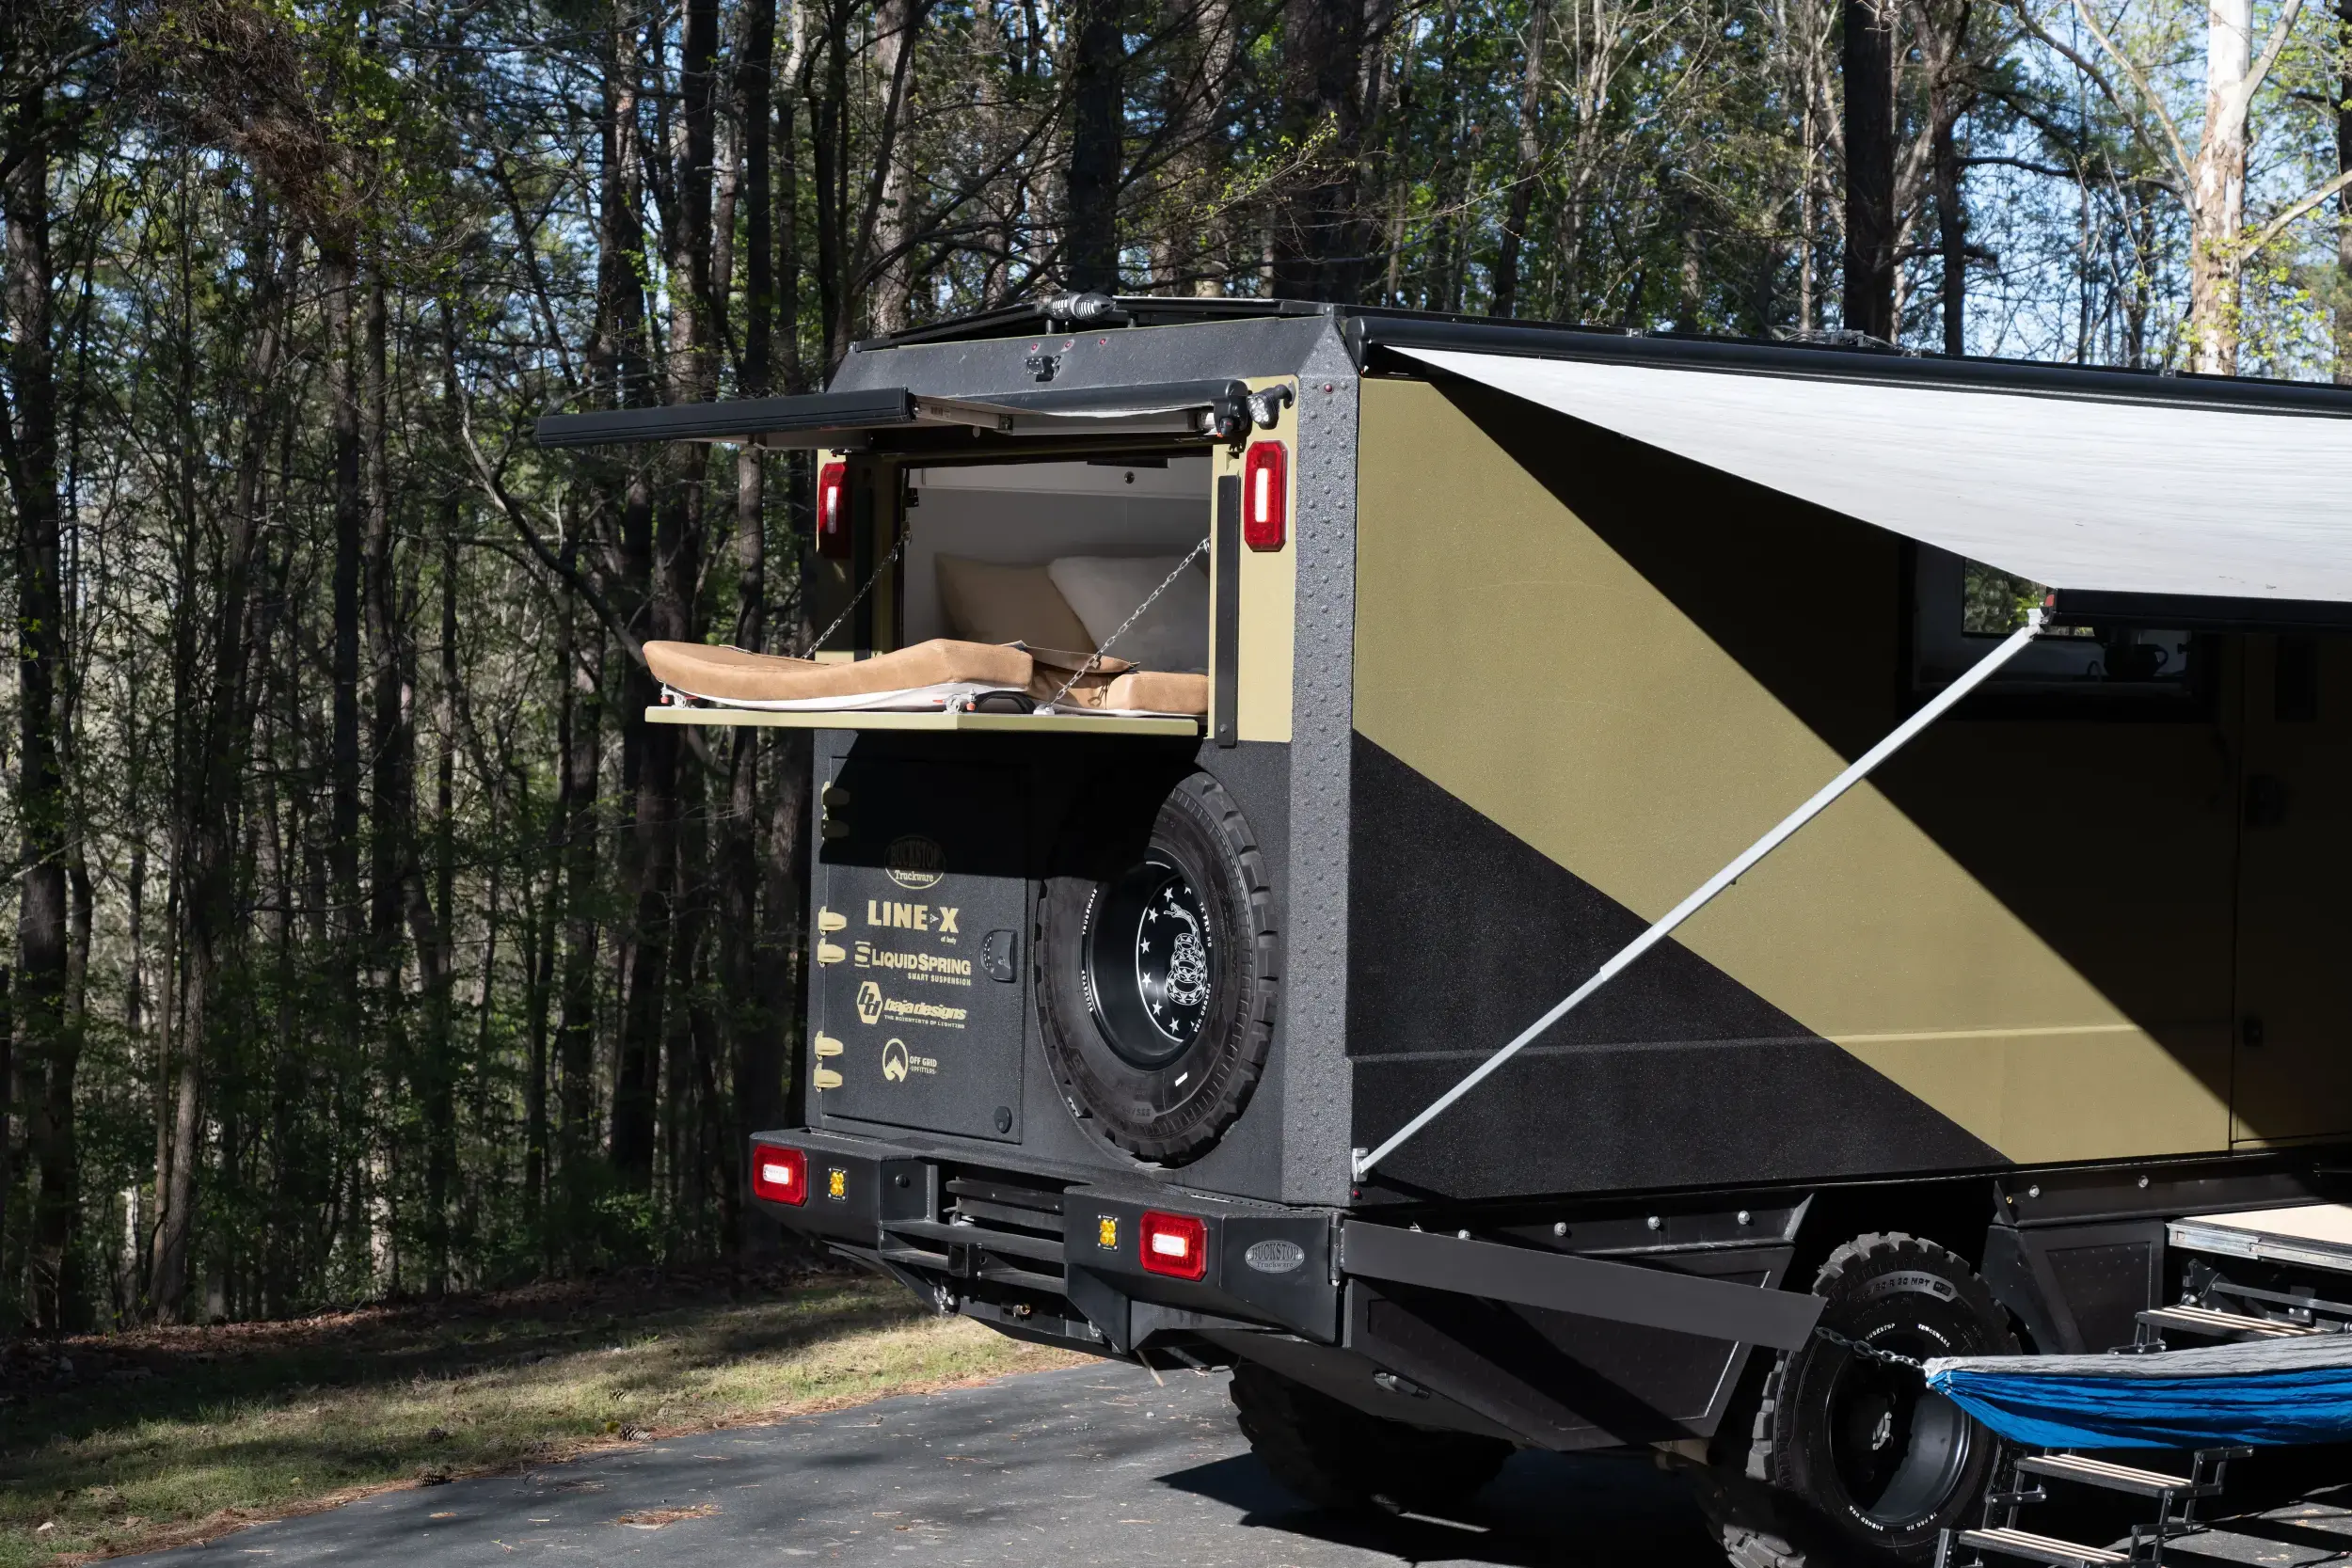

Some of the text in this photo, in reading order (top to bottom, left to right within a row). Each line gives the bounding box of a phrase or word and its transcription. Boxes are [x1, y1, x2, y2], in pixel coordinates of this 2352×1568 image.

[890, 838, 939, 870] BUCKSTOP
[895, 869, 934, 882] Truckware
[1082, 888, 1098, 935] TRUCKWARE
[908, 973, 971, 986] SMART SUSPENSION
[1081, 970, 1093, 1013] BUCKSTOP
[1193, 983, 1211, 1033] FORGED USA
[910, 1055, 937, 1068] OFF GRID
[1251, 1243, 1298, 1260] BUCKSTOP
[1911, 1277, 1931, 1288] MPT
[1917, 1323, 1950, 1348] TRUCKWARE
